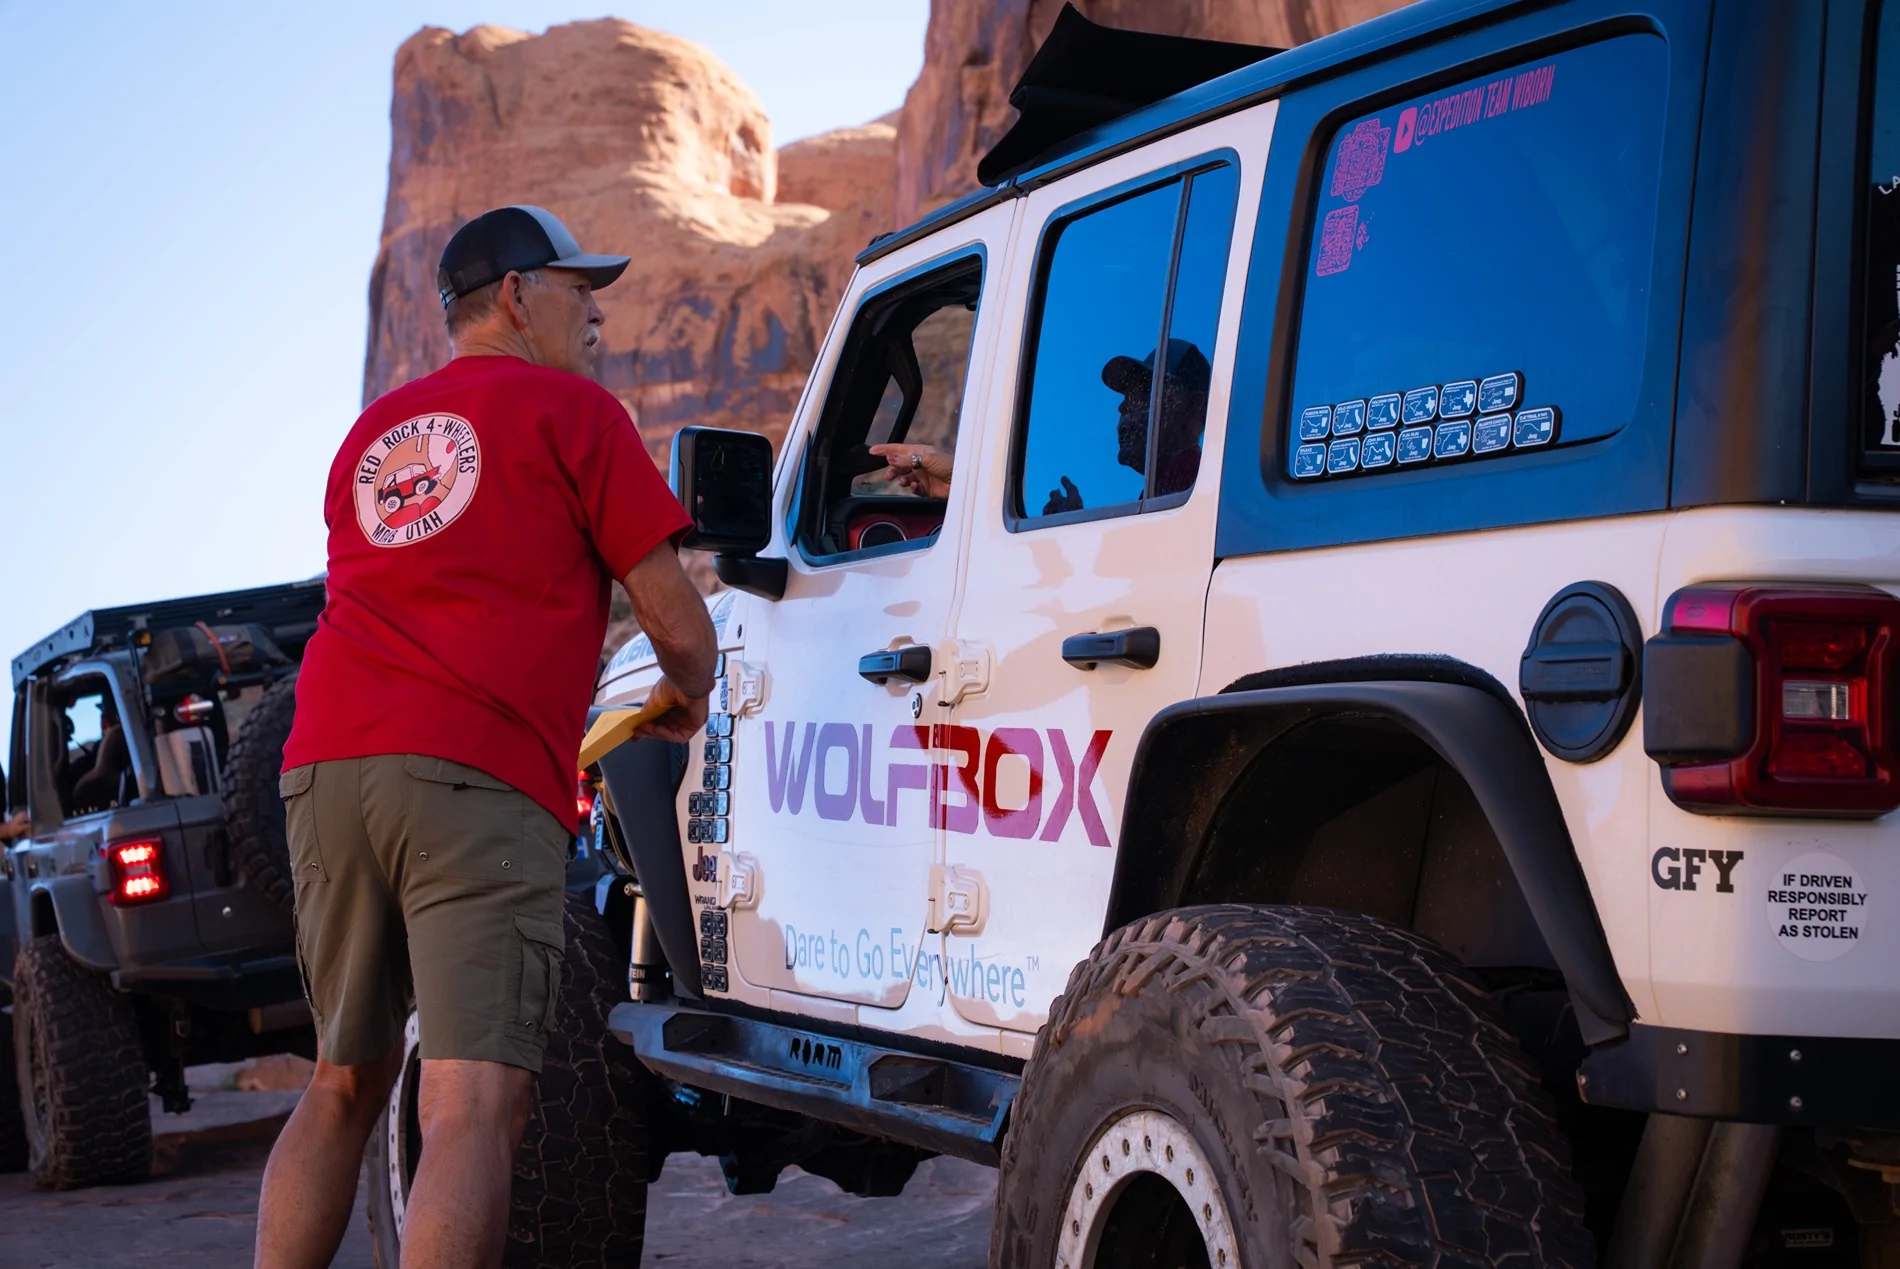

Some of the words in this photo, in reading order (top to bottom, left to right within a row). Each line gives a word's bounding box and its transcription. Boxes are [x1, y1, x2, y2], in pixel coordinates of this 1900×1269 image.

[1414, 86, 1485, 146] @EXPEDITION
[1483, 77, 1513, 120] TEAM
[358, 454, 381, 484] RED
[382, 420, 420, 450] ROCK
[426, 417, 476, 474] 4-WHEELERS
[405, 511, 443, 540] UTAH
[764, 720, 1114, 848] WOLFBOX
[693, 845, 717, 882] Jee
[1651, 846, 1744, 894] GFY
[1768, 890, 1868, 906] RESPONSIBLY
[1783, 874, 1796, 887] IF
[1800, 874, 1852, 889] DRIVEN
[694, 894, 716, 905] WRANG
[1788, 908, 1848, 922] REPORT
[1778, 924, 1799, 938] AS
[1802, 925, 1859, 940] STOLEN
[785, 924, 825, 971] Dare
[831, 928, 850, 979] to
[856, 928, 884, 980] Go
